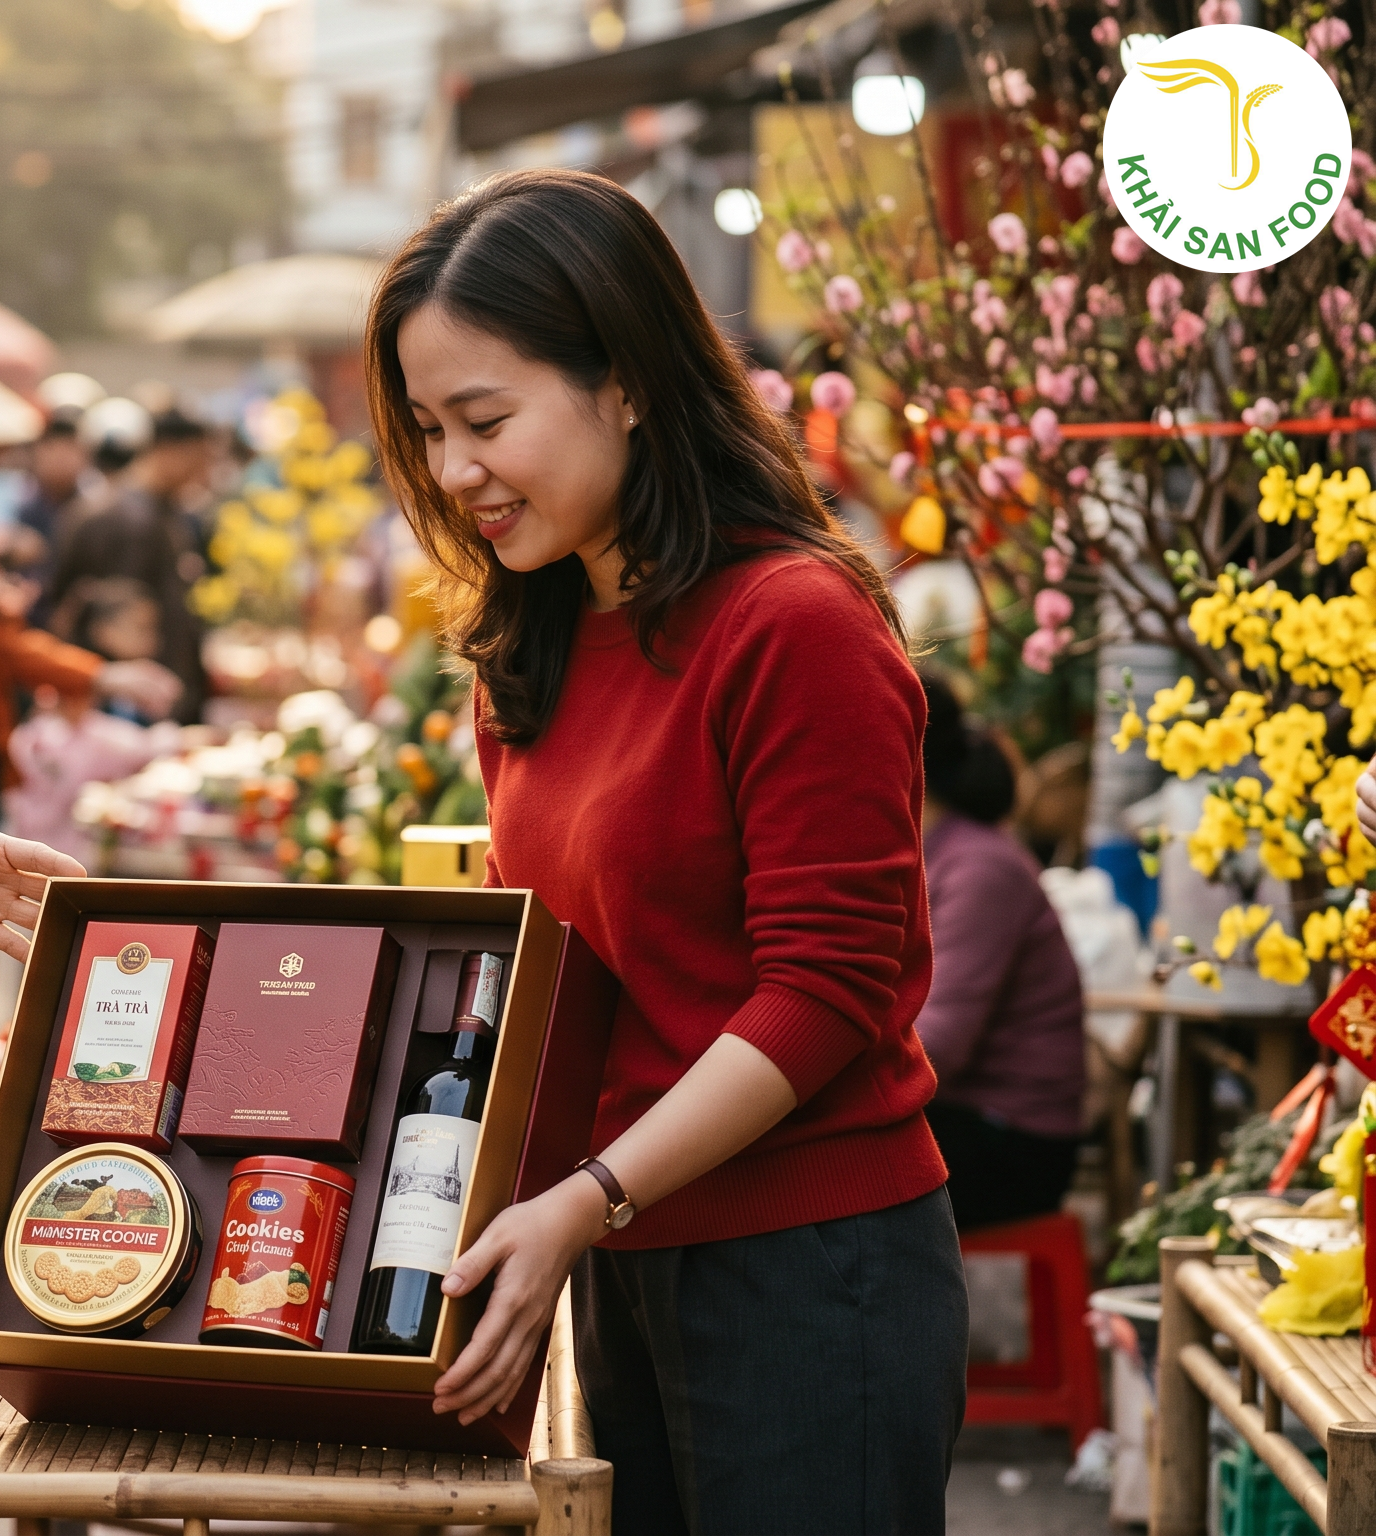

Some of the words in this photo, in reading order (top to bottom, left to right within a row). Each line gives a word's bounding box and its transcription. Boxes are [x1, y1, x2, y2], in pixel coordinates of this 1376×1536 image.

[95, 1000, 120, 1013] TRÀ
[124, 1000, 149, 1014] TRÀ
[225, 1218, 306, 1244] Cookies
